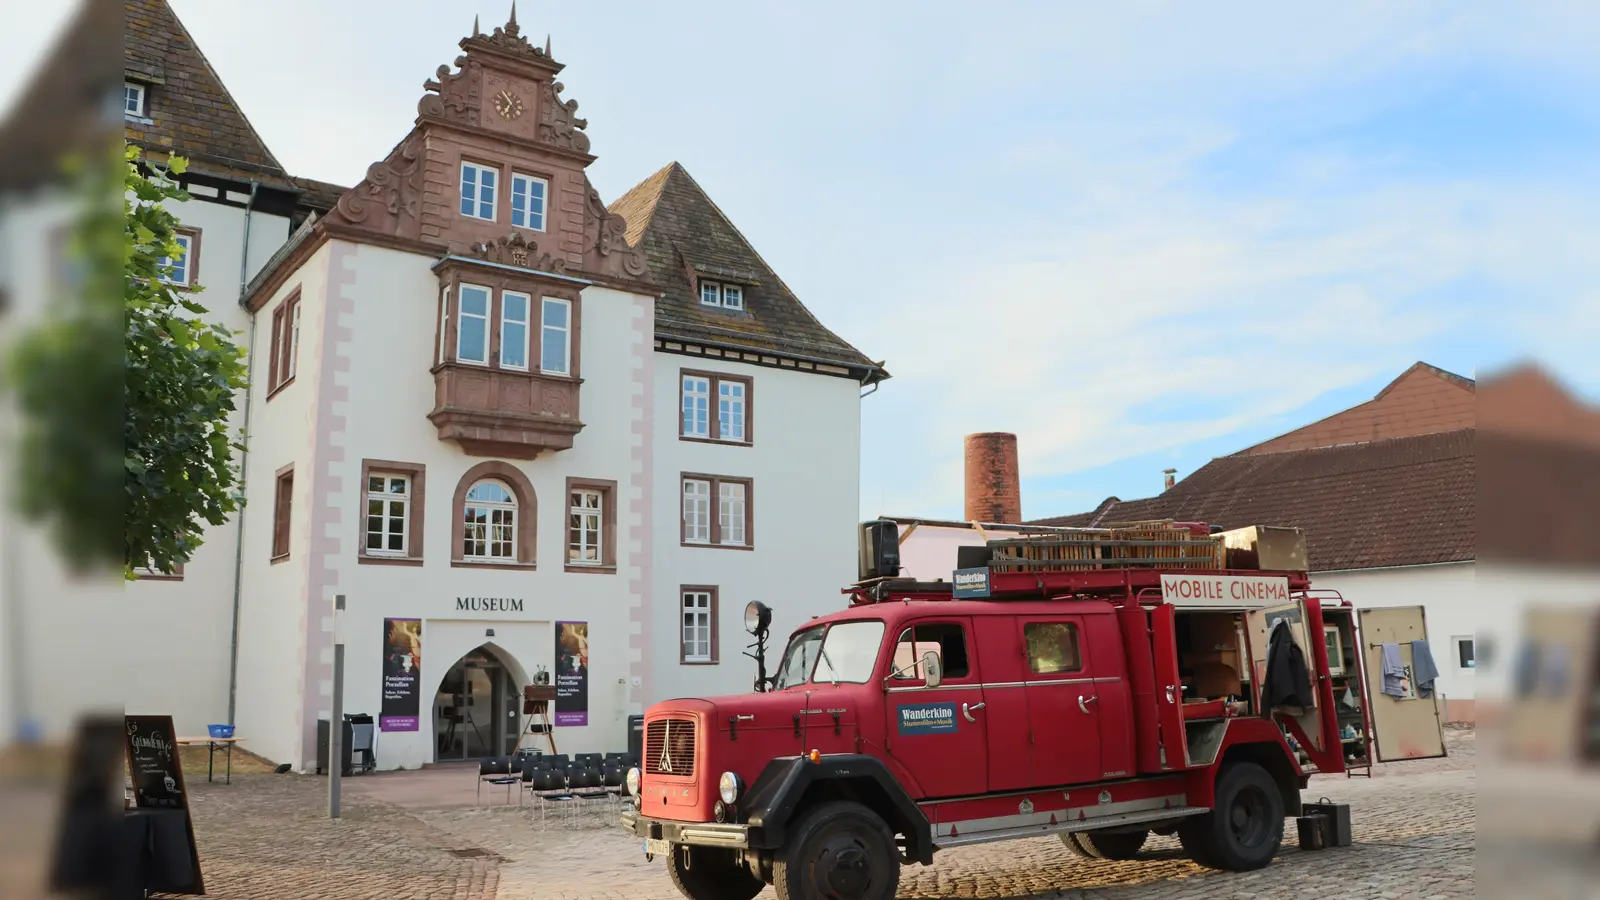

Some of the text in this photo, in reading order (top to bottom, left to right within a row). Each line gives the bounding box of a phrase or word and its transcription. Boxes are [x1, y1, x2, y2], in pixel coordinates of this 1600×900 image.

[1164, 579, 1288, 600] MOBILE CINEMA
[456, 597, 524, 611] MUSEUM
[902, 707, 953, 720] Wanderkino
